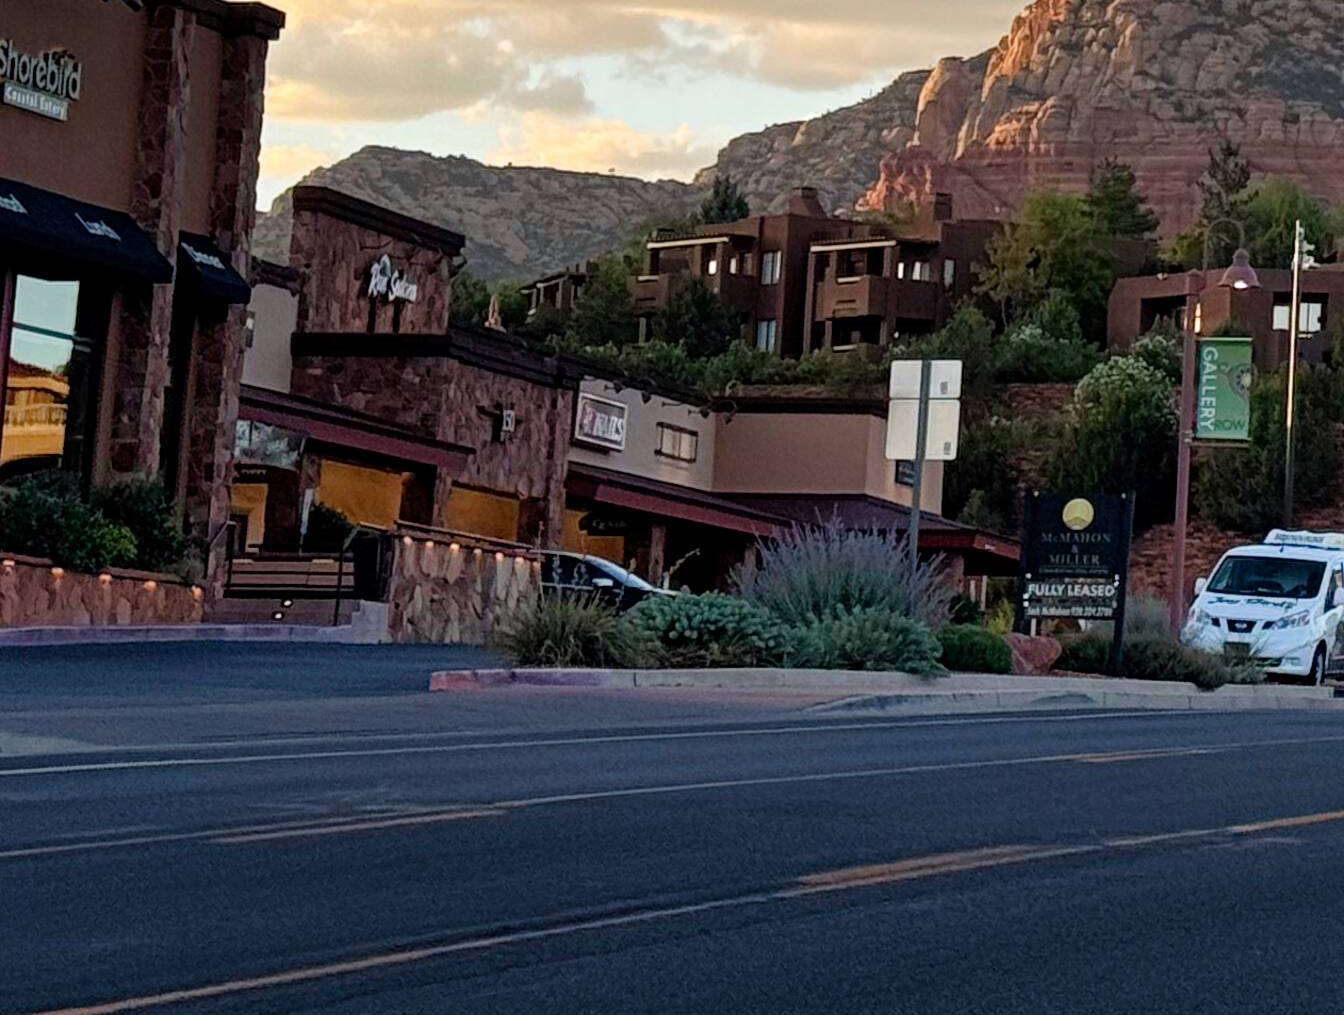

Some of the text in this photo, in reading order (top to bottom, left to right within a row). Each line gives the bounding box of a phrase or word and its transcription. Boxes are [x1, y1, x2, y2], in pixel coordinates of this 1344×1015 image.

[1200, 346, 1219, 432] GALLERY
[1048, 554, 1101, 567] MILLER
[1028, 584, 1115, 597] FULLY LEASED
